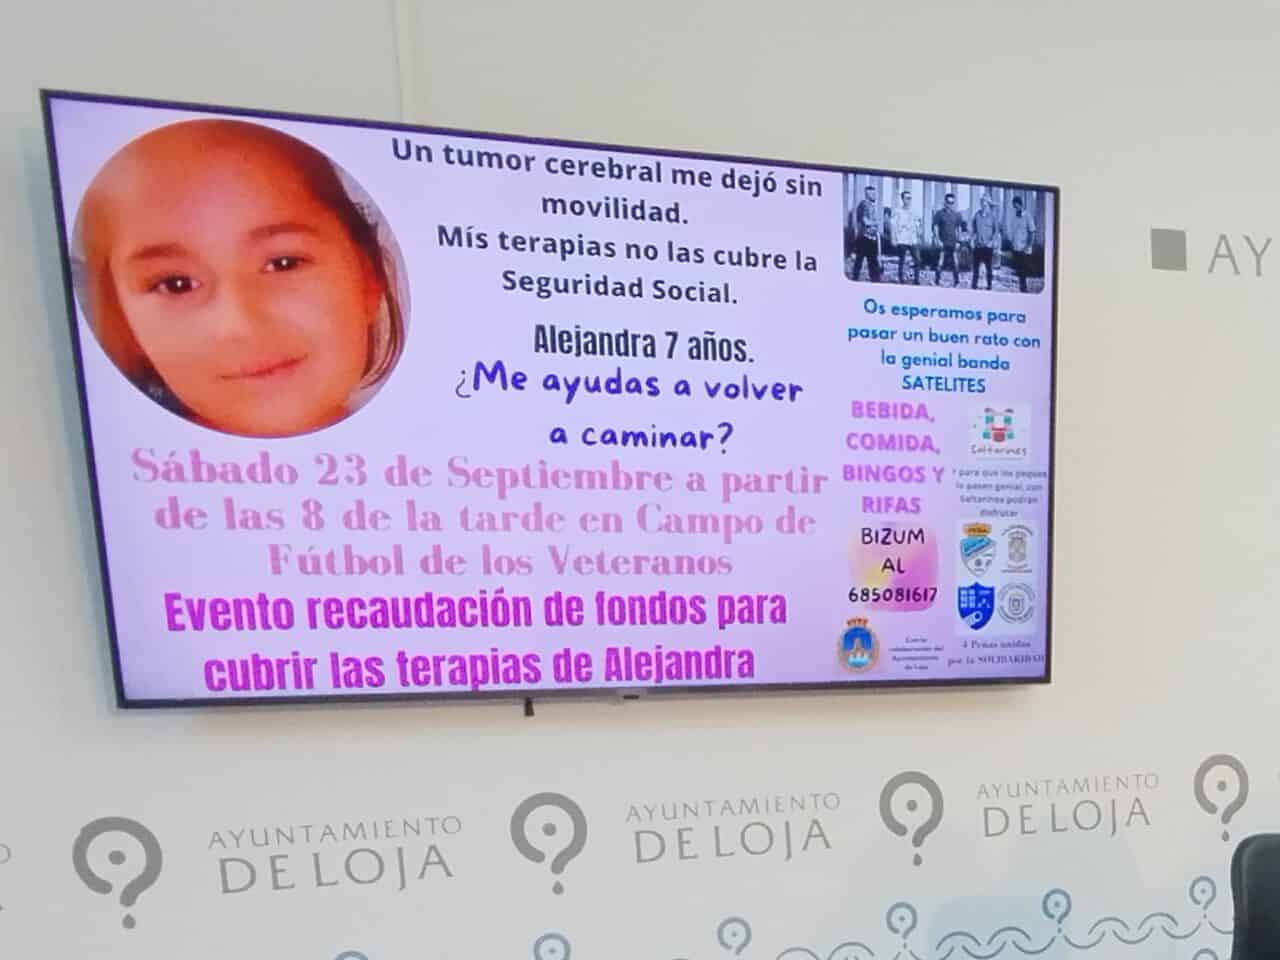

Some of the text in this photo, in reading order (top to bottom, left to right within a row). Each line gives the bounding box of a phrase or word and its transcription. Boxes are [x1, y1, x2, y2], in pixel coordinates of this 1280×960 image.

[392, 138, 823, 199] Un tumor cerebral me dejó sin
[542, 194, 689, 225] movilidad.
[437, 224, 818, 272] Mís terapias no las cubre la
[502, 270, 738, 305] Seguridad Social.
[863, 298, 1026, 325] Os esperamos para
[534, 323, 755, 364] Alejandra 7 años.
[848, 327, 1041, 349] pasar un buen rato con
[881, 349, 1010, 371] la genial banda
[455, 359, 804, 404] ¿Me ayudas a volver
[901, 375, 987, 394] SATELITES
[850, 400, 936, 423] BEBIDA,
[549, 421, 734, 454] a caminar?
[845, 433, 941, 455] COMIDA,
[131, 447, 830, 503] Sábado 23 de Septiembre a partir
[842, 464, 945, 484] BINGOS Y
[154, 496, 817, 545] de las 8 de la tarde en Campo de
[861, 495, 922, 514] RIFAS
[861, 527, 925, 546] BIZUM
[268, 543, 734, 577] Fútbol de los Veteranos
[881, 557, 907, 574] AL
[164, 586, 789, 632] Evento recaudación de fondos para
[848, 587, 938, 603] 685081617
[203, 645, 755, 692] cubrir las terapias de Alejandra
[977, 773, 1159, 800] AYUNTAMIENTO
[625, 792, 841, 823] AYUNTAMIENTO
[983, 797, 1150, 838] DE LOJA
[208, 815, 462, 849] AYUNTAMIENTO
[634, 818, 832, 863] DE LOJA
[219, 844, 453, 894] DE LOJA
